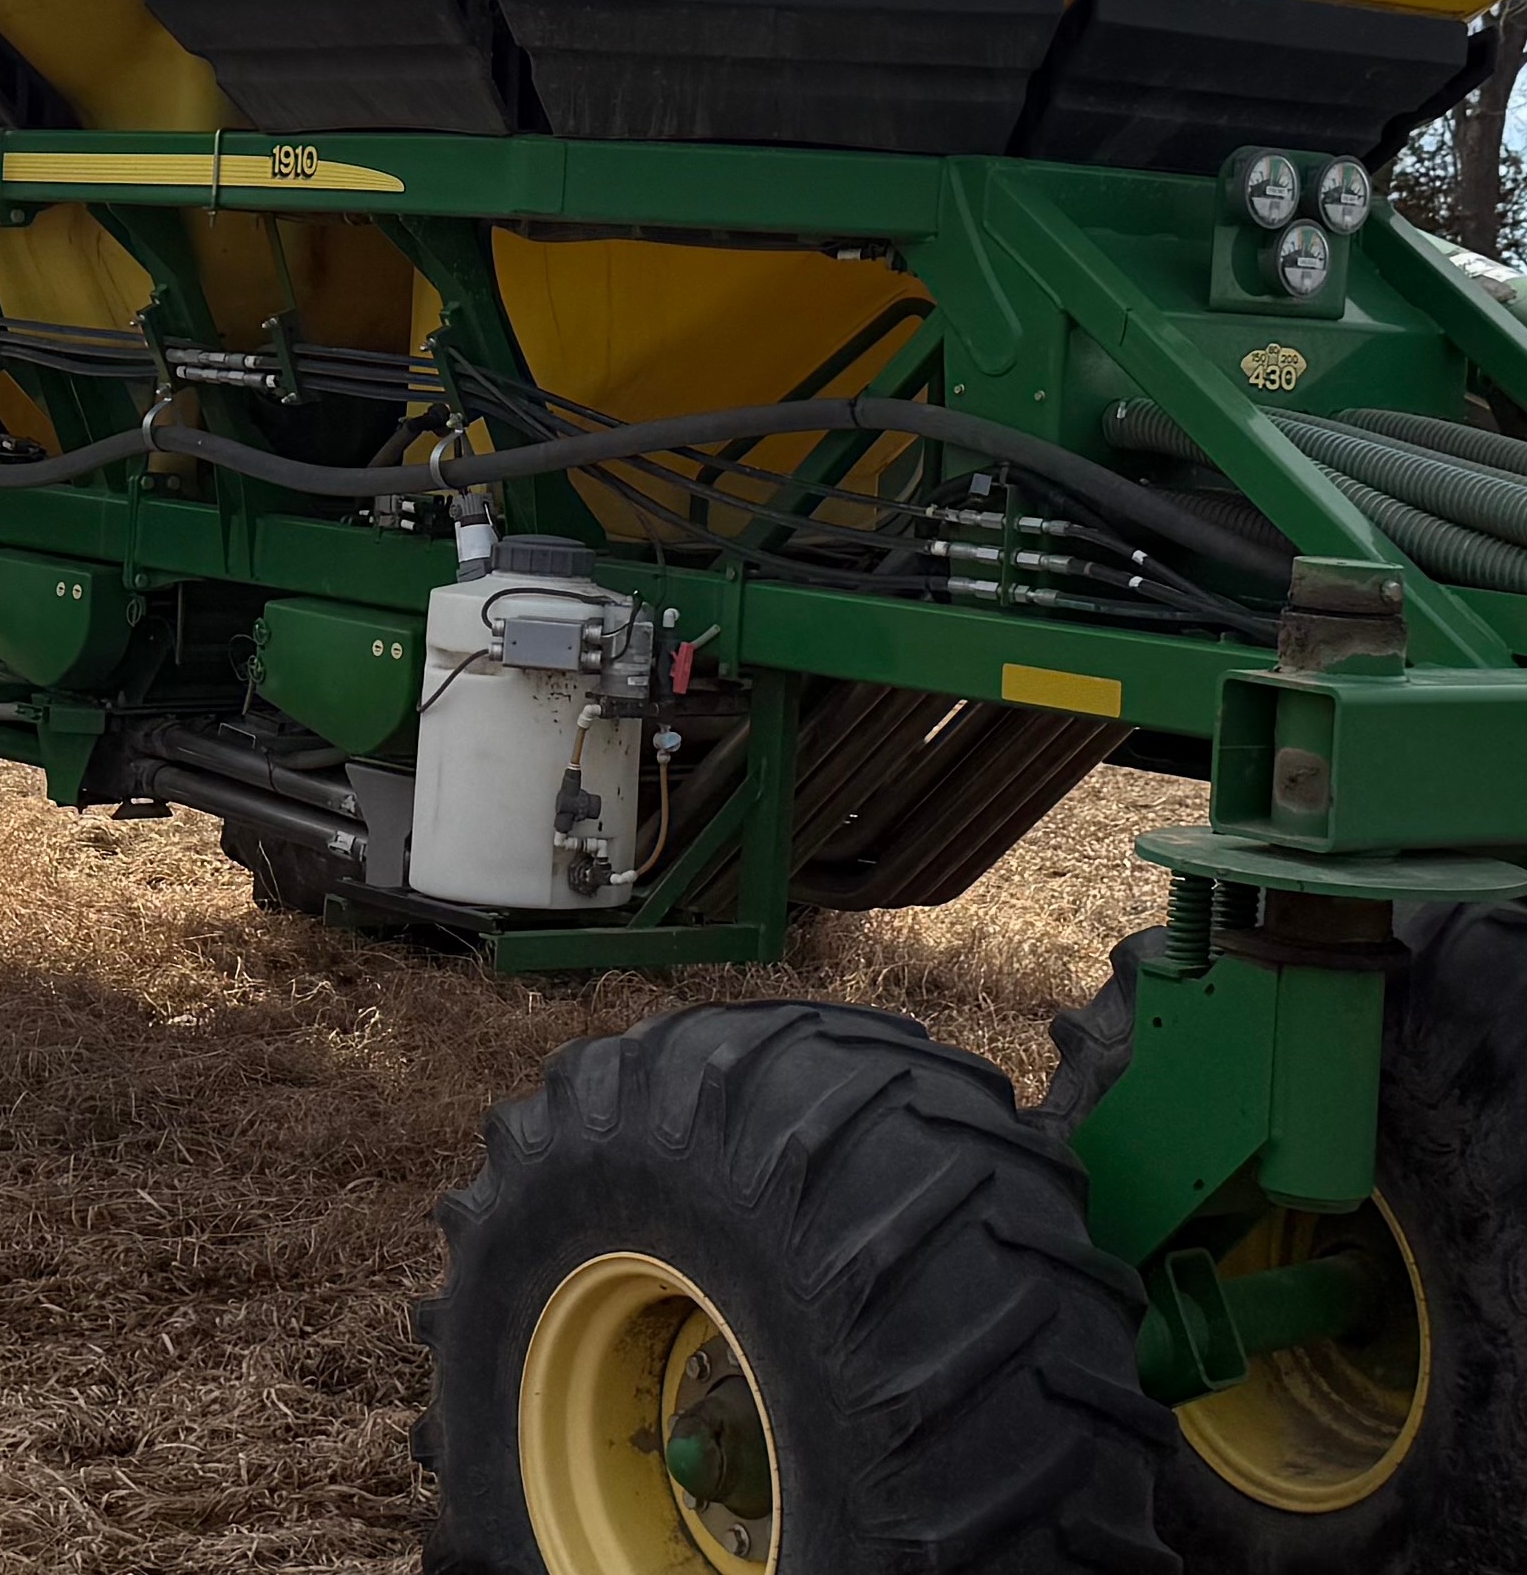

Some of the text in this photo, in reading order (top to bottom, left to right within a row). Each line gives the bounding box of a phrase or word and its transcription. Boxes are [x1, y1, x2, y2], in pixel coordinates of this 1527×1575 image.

[272, 144, 319, 177] 1910
[1280, 354, 1299, 364] 200
[1249, 364, 1297, 391] 430
